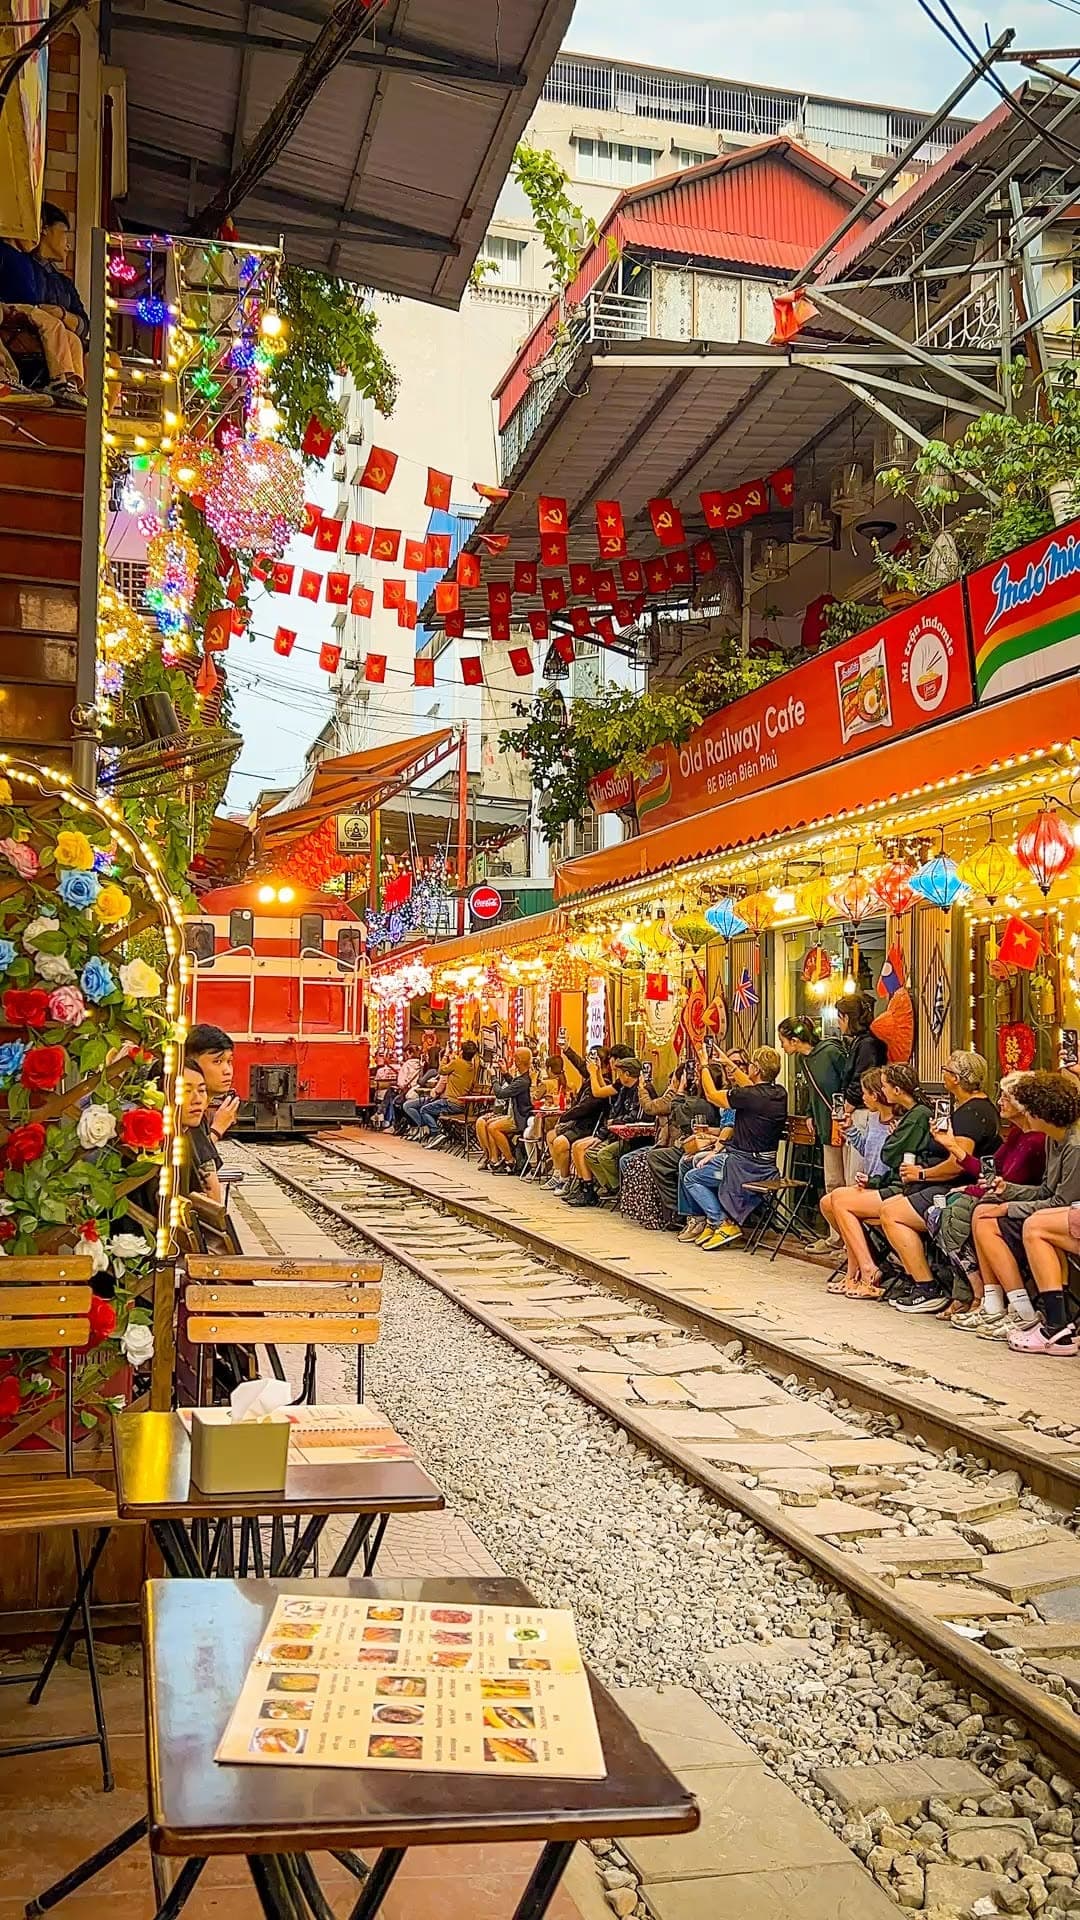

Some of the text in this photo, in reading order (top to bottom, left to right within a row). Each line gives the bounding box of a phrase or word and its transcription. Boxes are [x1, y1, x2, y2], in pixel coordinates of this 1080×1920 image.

[921, 615, 954, 657] Indomie
[679, 743, 703, 778] Old
[704, 721, 761, 768] Railway
[765, 695, 806, 738] Cafe
[707, 777, 717, 795] 8E
